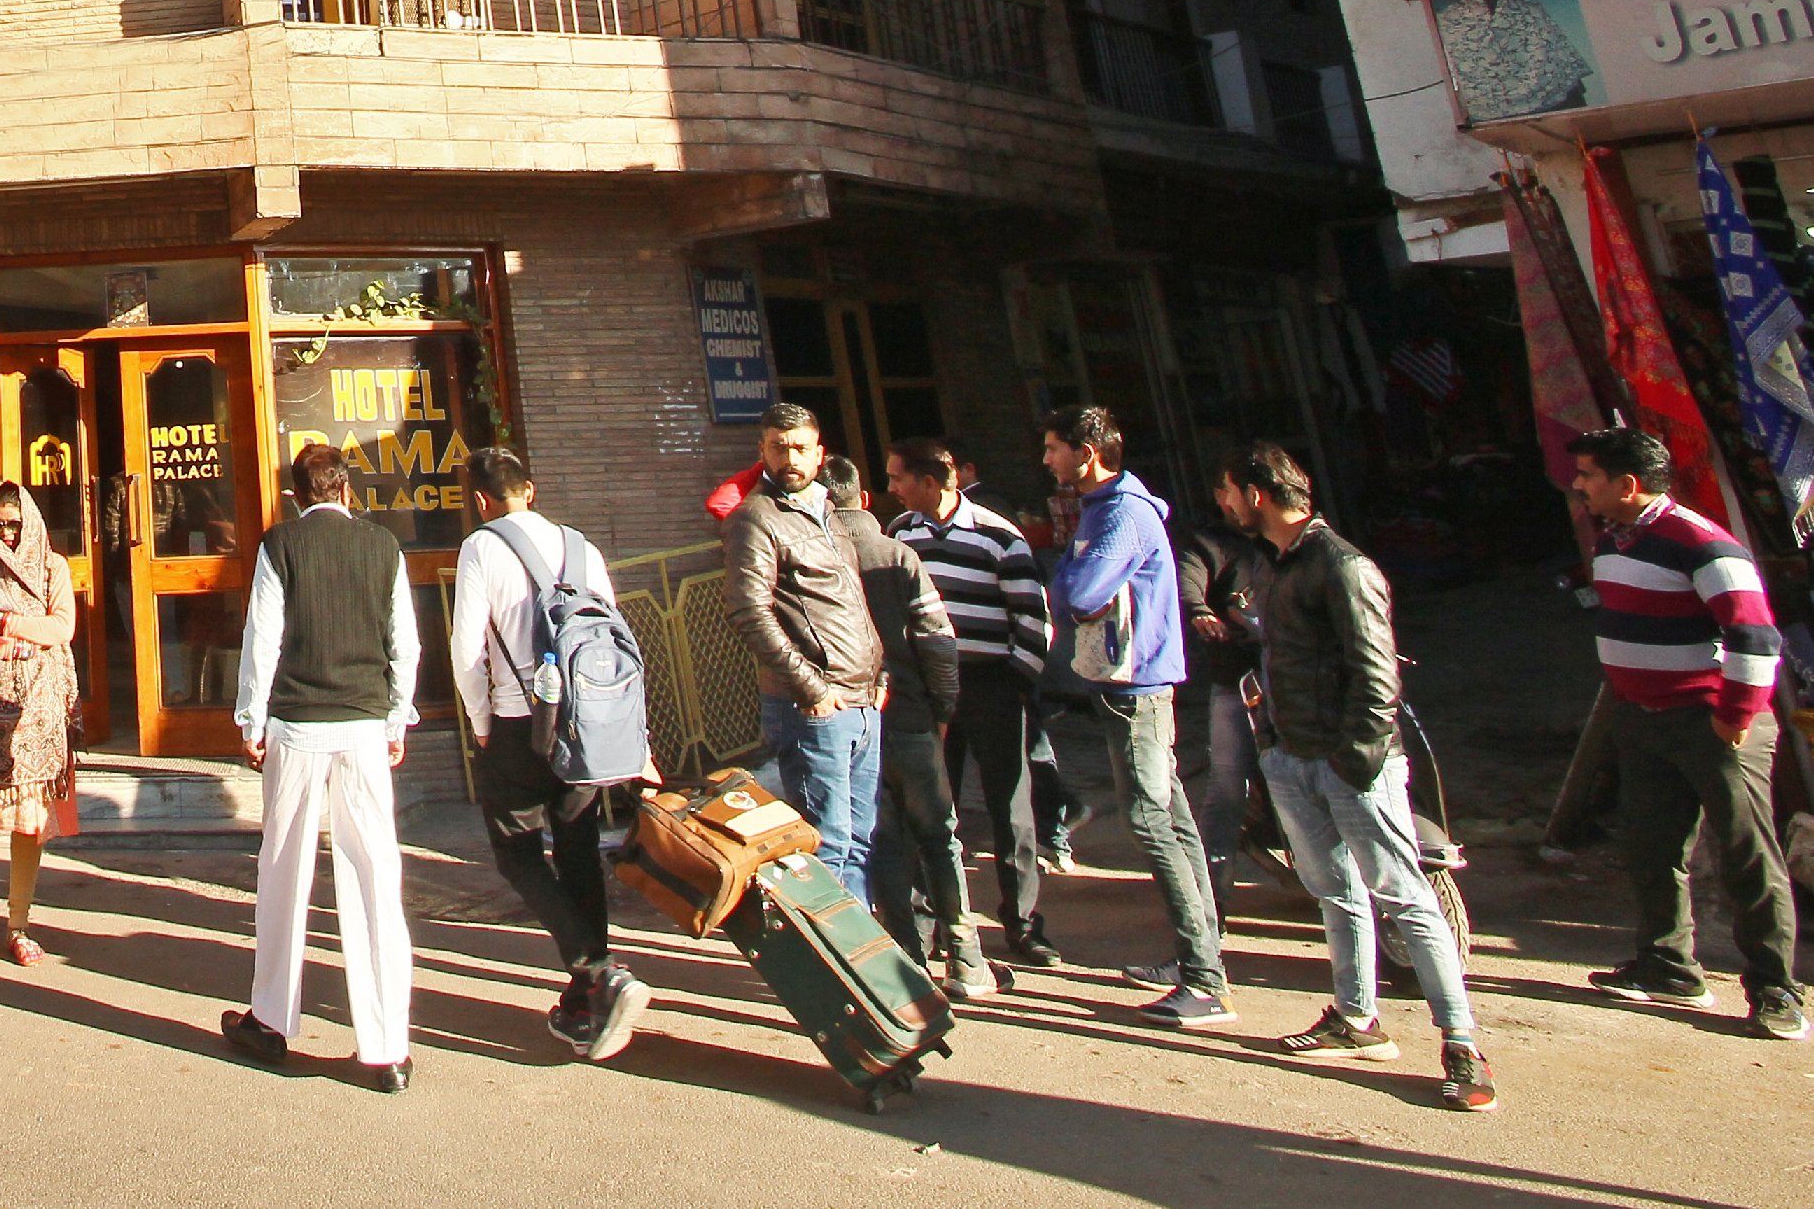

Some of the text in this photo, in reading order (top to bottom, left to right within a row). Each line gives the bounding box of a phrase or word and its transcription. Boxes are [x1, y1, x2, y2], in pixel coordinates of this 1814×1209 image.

[704, 279, 745, 303] AKSHAR
[700, 308, 759, 335] MEDICOS
[706, 338, 762, 359] CHEMIST
[330, 369, 446, 422] HOTEL
[150, 423, 230, 448] HOTEL
[152, 447, 219, 465] RAMA
[153, 464, 224, 481] PALACE
[348, 484, 465, 512] ALACE
